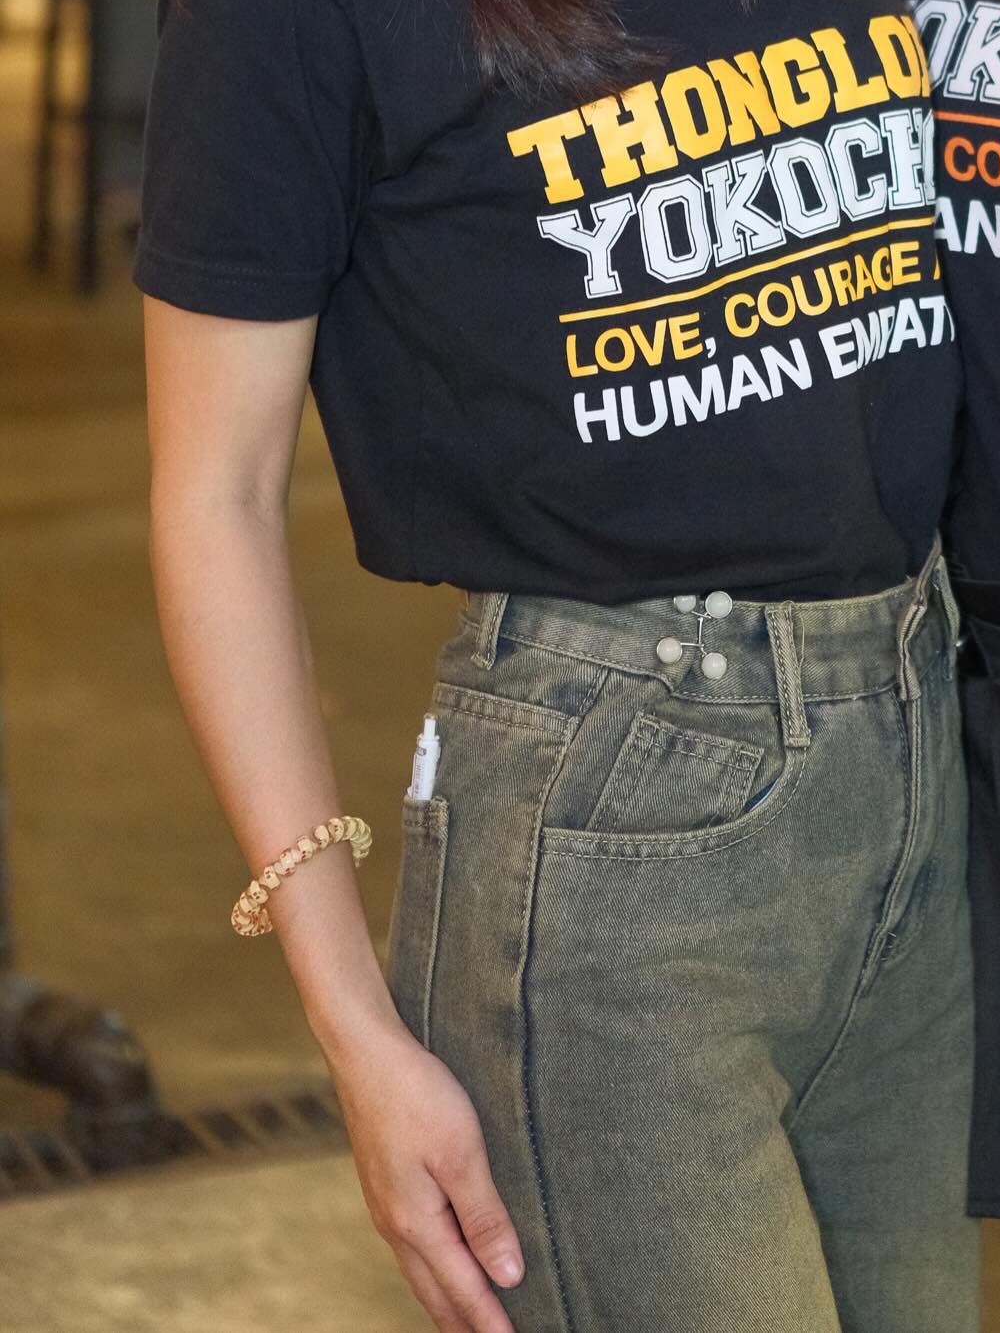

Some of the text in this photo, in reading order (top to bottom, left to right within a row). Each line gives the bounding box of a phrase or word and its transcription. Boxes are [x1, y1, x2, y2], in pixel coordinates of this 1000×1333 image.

[566, 312, 716, 378] LOVE,
[724, 240, 922, 339] COURAGE
[573, 295, 956, 443] HUMAN EMPAT
